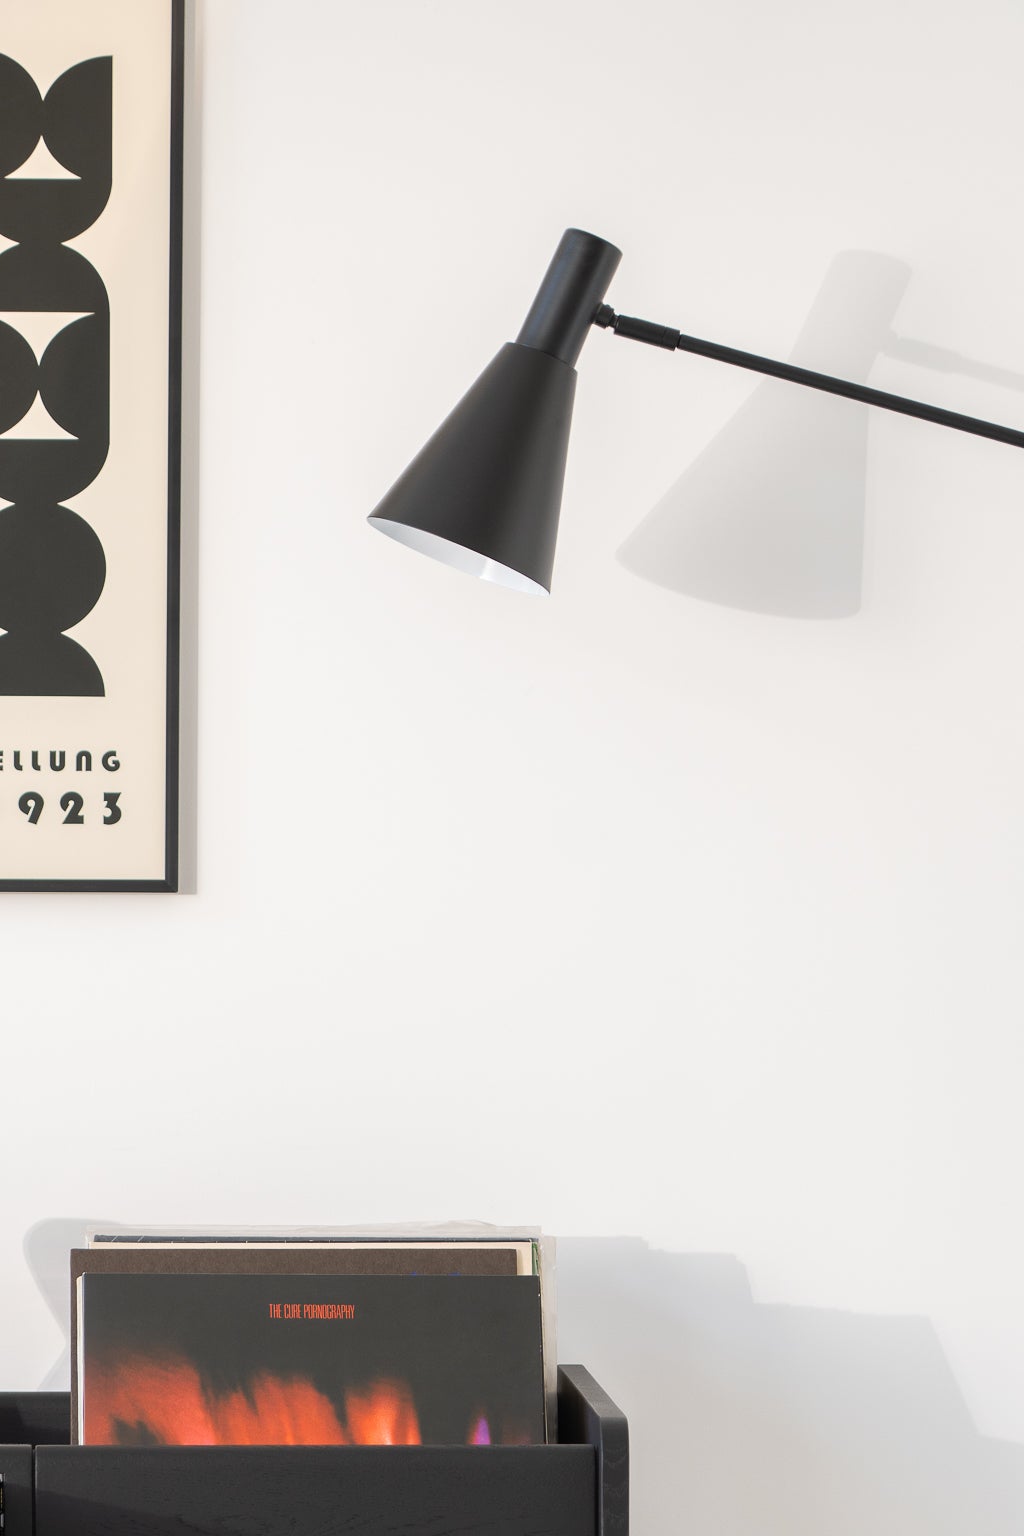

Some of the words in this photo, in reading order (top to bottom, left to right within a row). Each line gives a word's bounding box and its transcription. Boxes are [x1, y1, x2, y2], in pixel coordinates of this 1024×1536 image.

[269, 1303, 282, 1319] THE
[283, 1303, 302, 1319] CURE
[303, 1304, 355, 1319] PORNOGRAPHY
